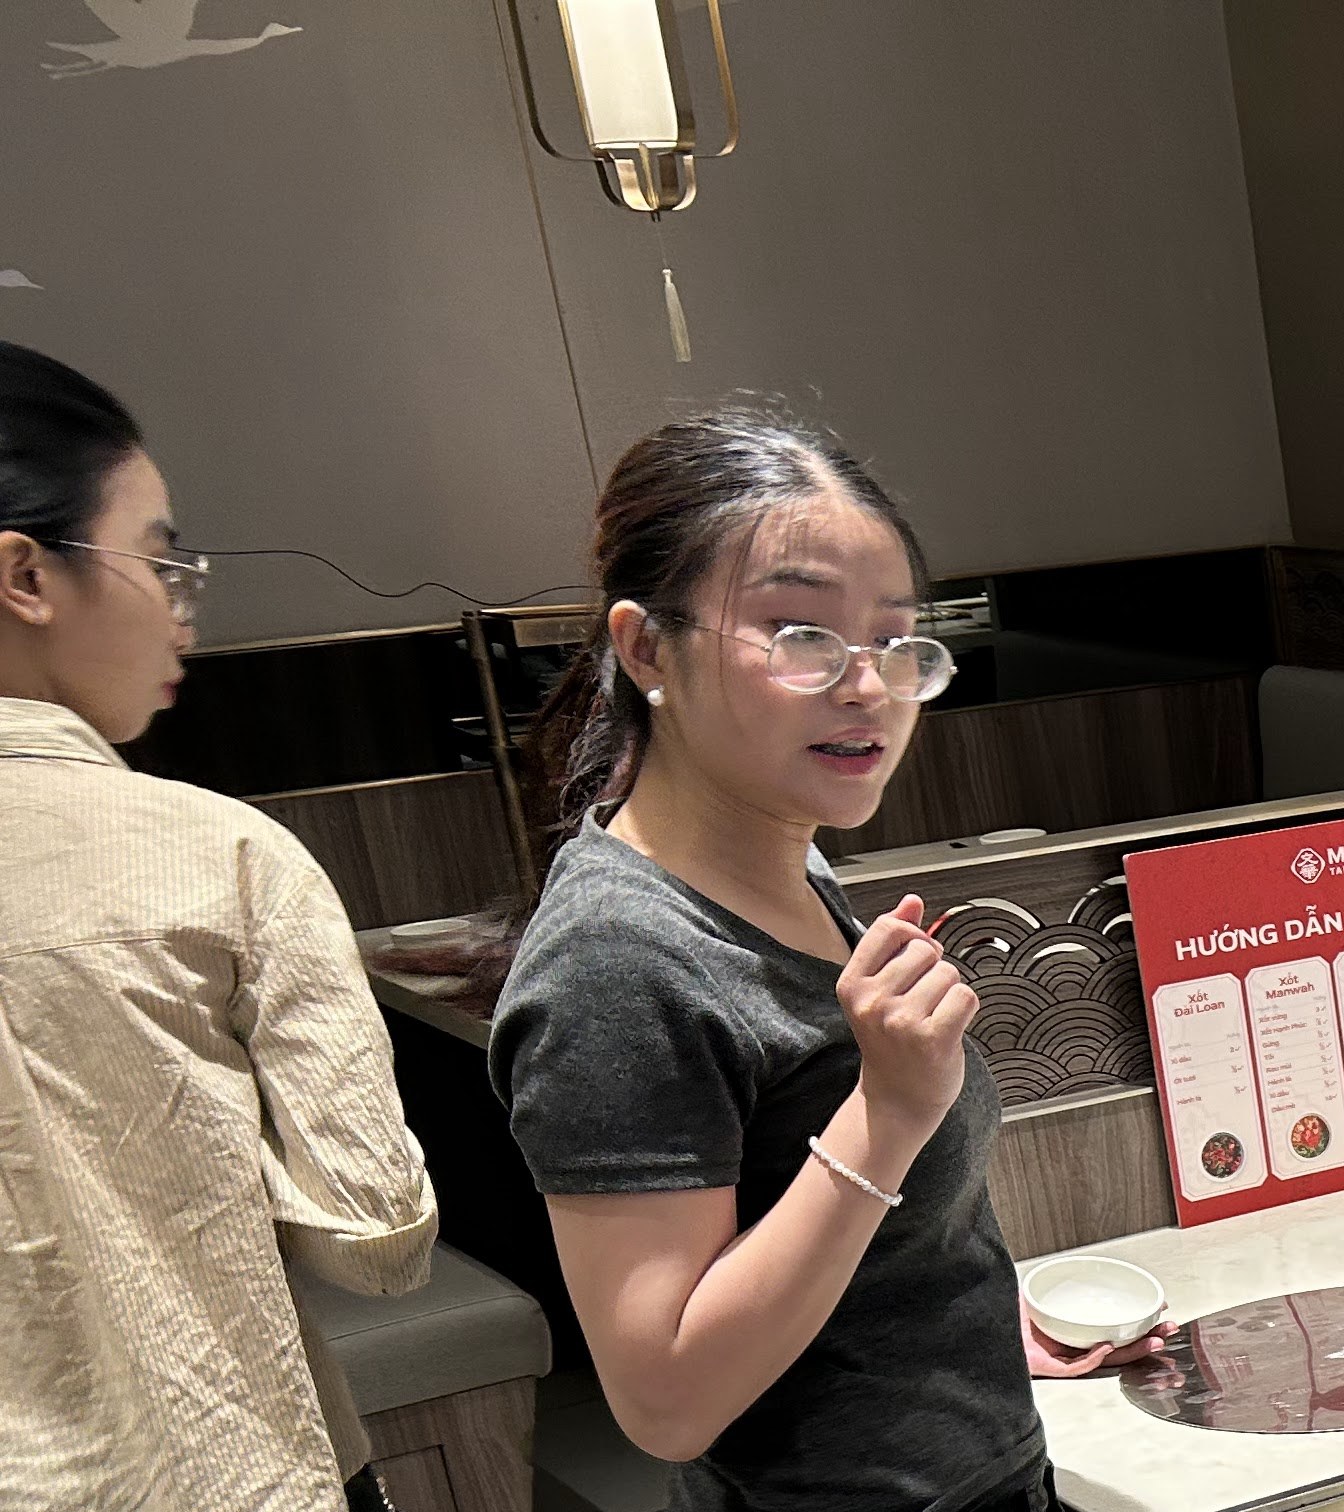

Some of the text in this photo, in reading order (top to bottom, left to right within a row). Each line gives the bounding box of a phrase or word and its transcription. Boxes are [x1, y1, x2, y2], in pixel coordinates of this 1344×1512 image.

[1175, 924, 1279, 961] HƯỚNG
[1284, 904, 1344, 941] DẪN
[1265, 982, 1315, 1000] Manwah
[1196, 1001, 1226, 1013] Loan
